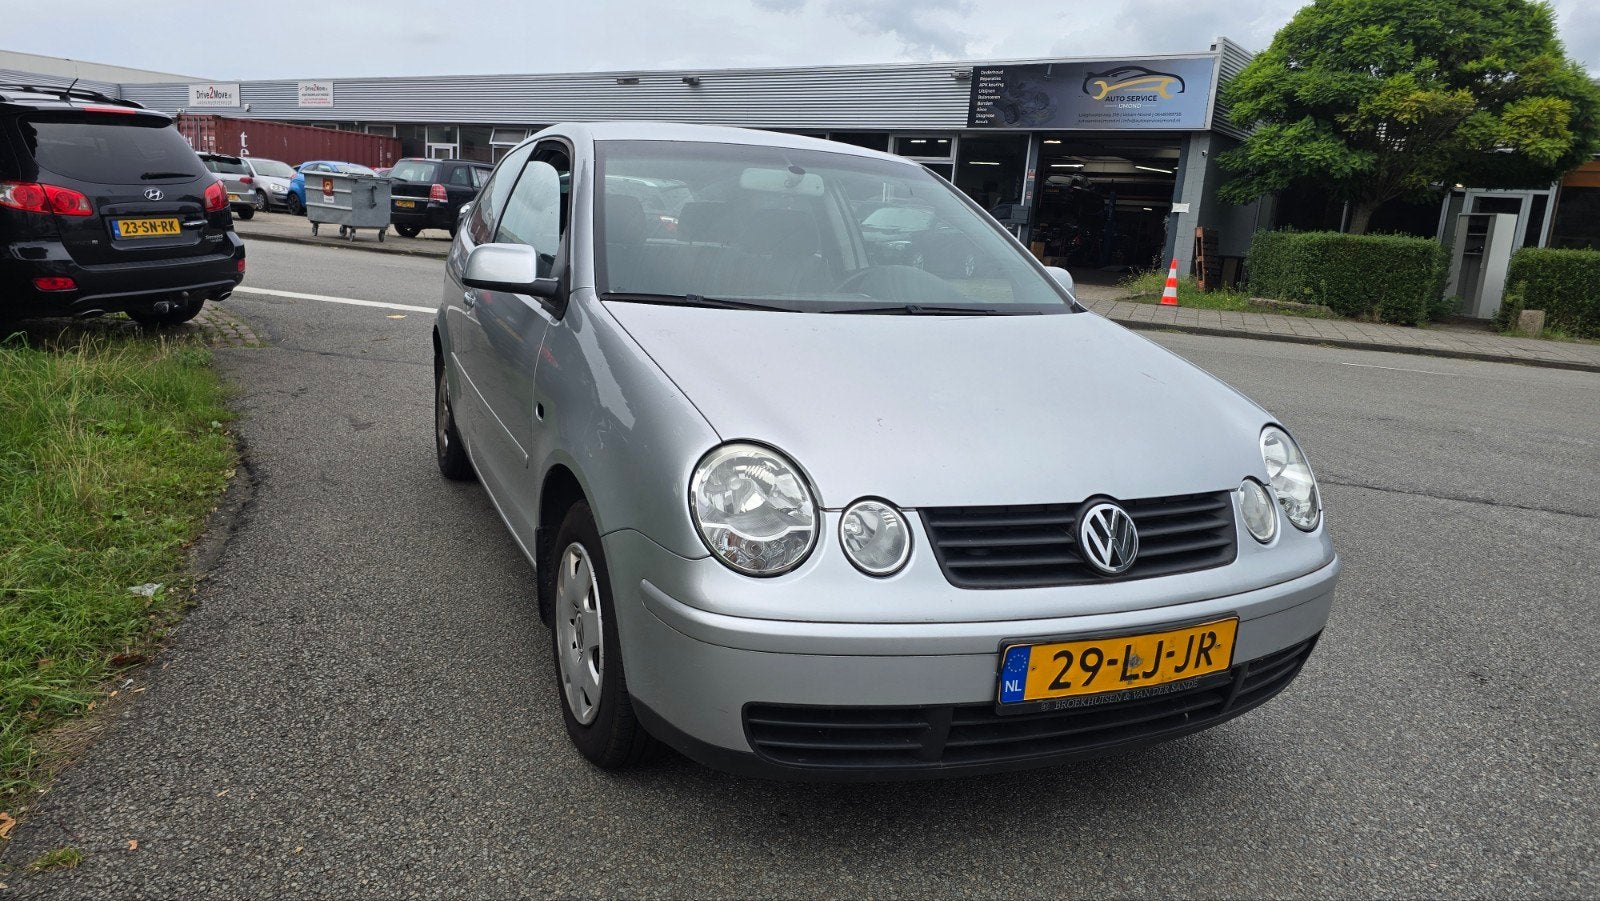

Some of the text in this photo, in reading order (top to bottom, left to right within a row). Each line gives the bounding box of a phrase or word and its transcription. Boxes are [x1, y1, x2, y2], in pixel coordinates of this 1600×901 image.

[1126, 94, 1158, 102] SERVICE
[122, 220, 177, 235] 23-SN-RK
[1047, 630, 1218, 691] 29-LJ-JR
[1004, 679, 1023, 693] NL
[1054, 695, 1121, 710] BROEKHUISEN
[1132, 688, 1151, 700] VAN
[1151, 684, 1171, 696] DER
[1170, 678, 1199, 693] SANDE
